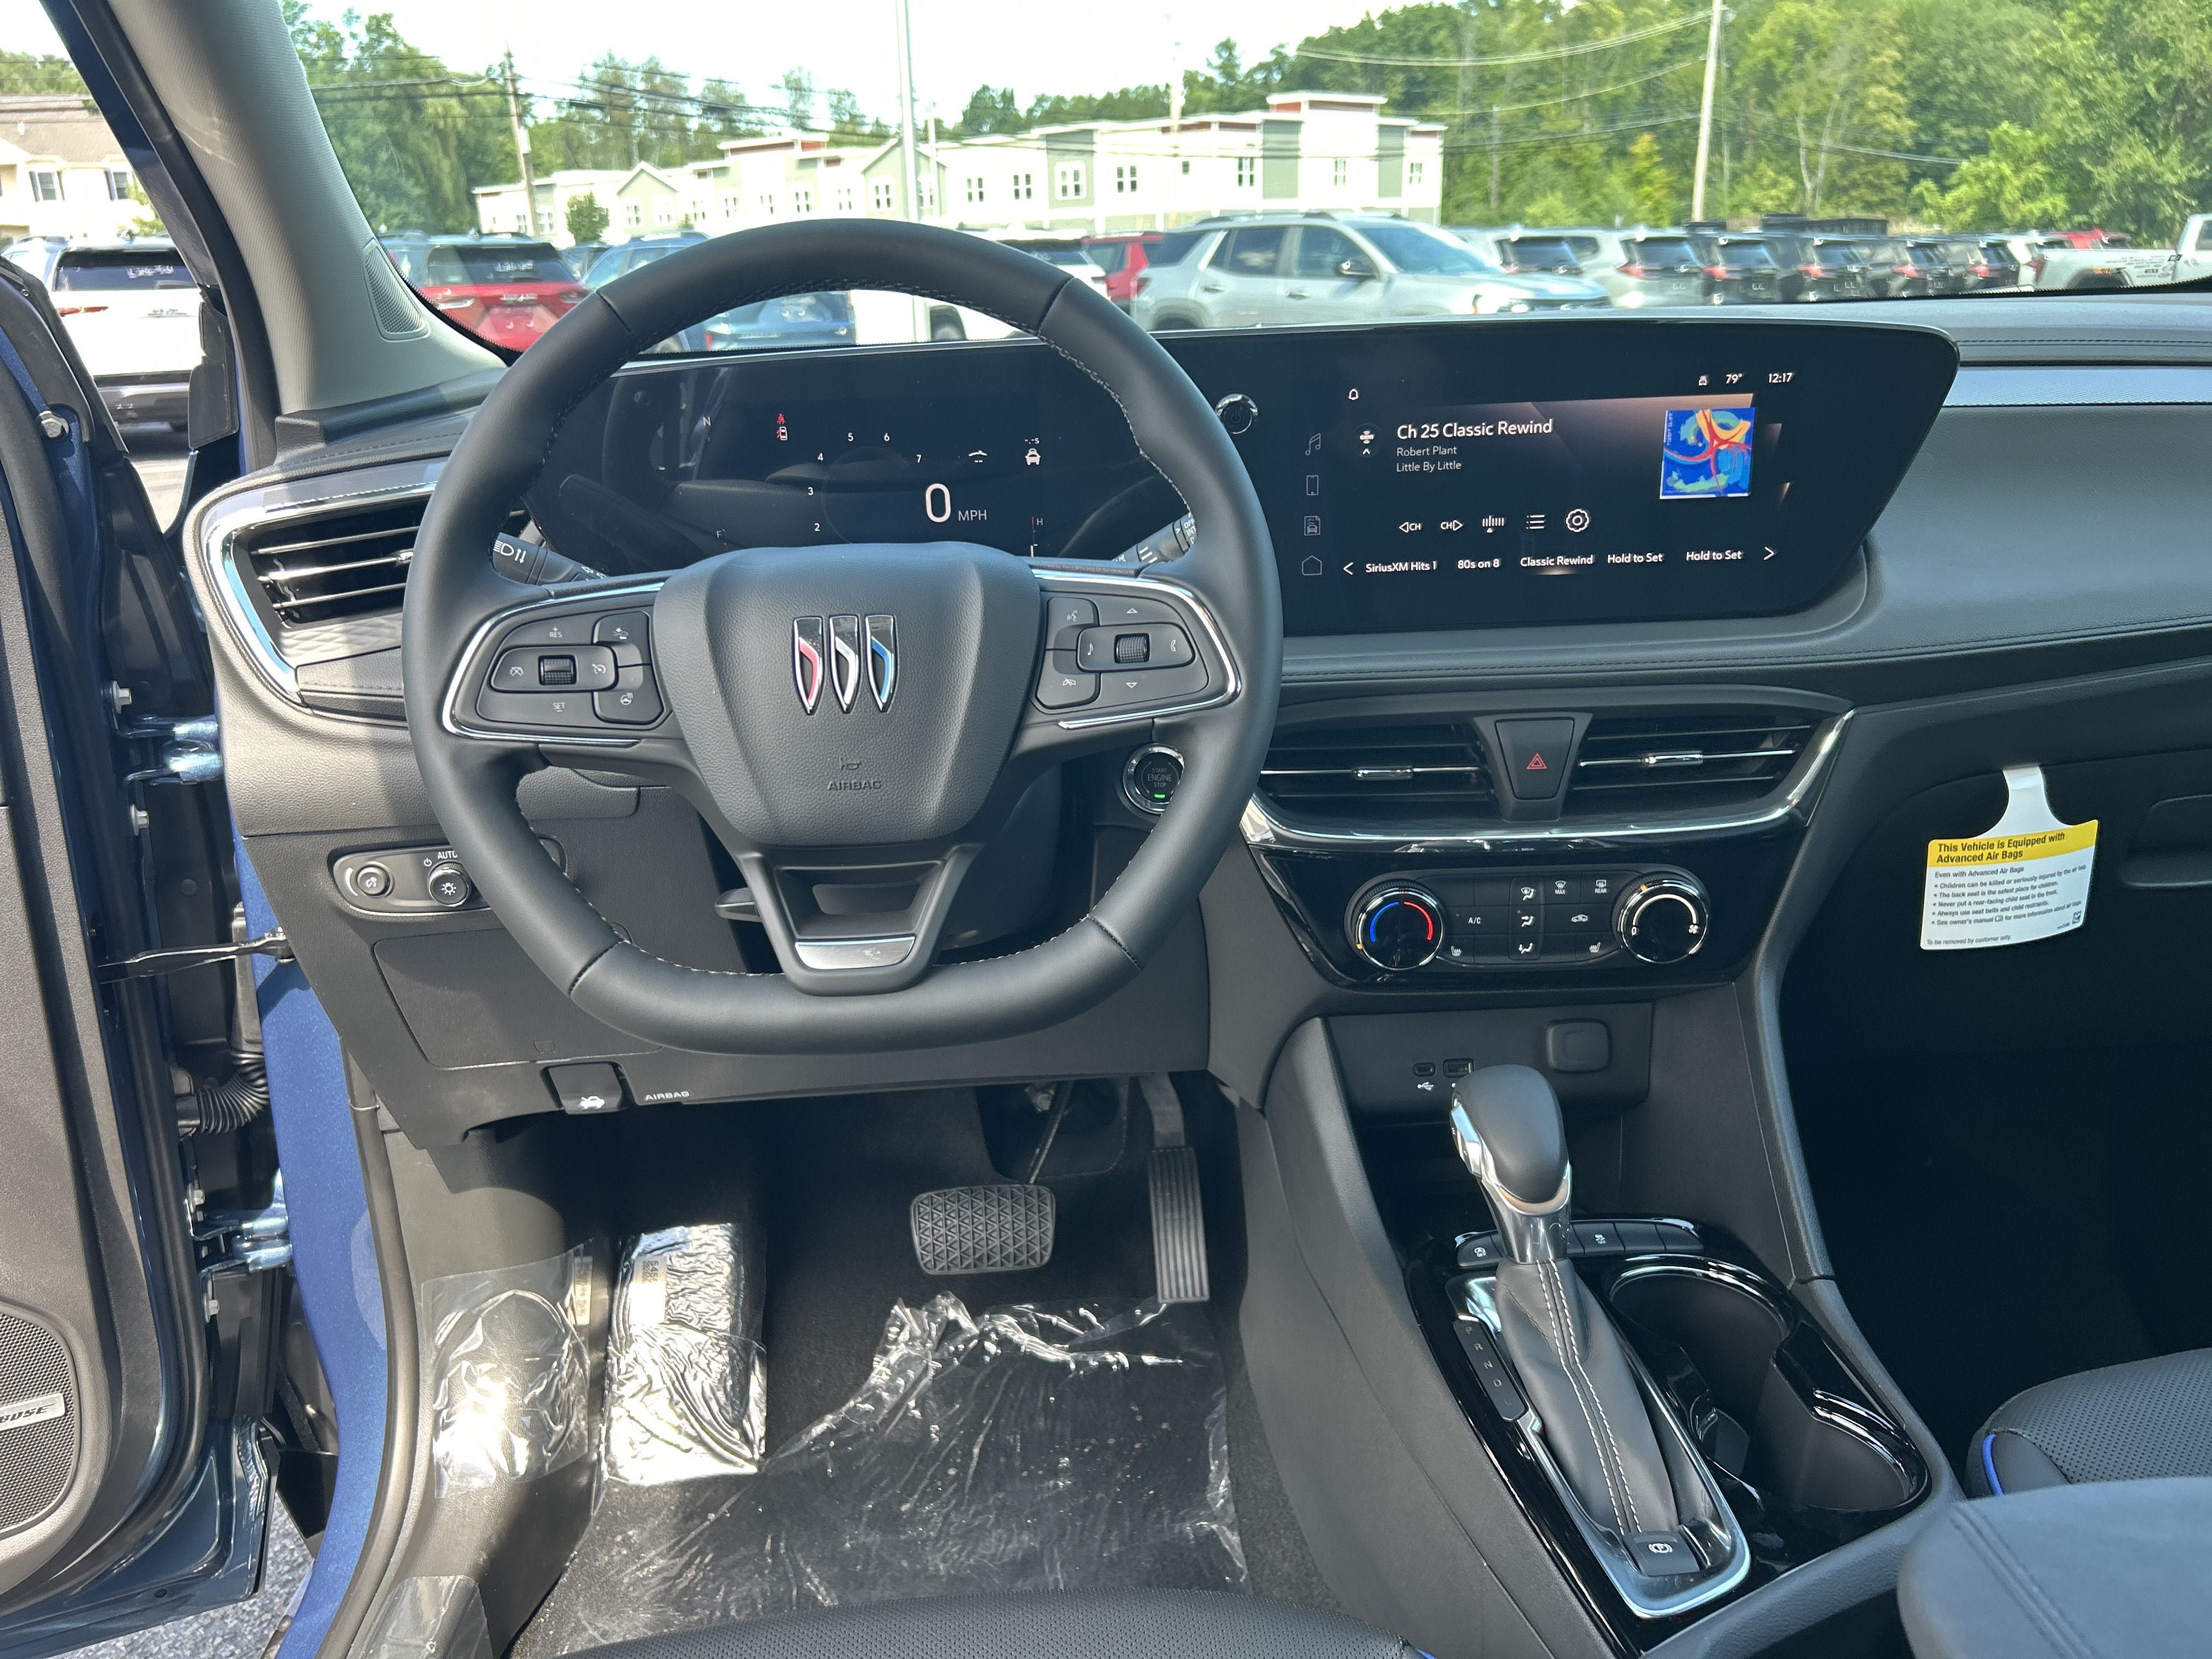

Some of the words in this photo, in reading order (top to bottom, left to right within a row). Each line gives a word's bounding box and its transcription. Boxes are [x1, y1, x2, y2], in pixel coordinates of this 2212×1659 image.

[1726, 373, 1742, 384] 79°
[1769, 373, 1793, 383] 12:17
[703, 416, 711, 426] N
[1397, 424, 1418, 439] Ch
[1420, 424, 1439, 438] 25
[1442, 422, 1493, 438] Classic
[1498, 419, 1553, 435] Rewind
[848, 433, 854, 442] 5
[884, 433, 890, 442] 6
[1396, 447, 1430, 456] Robert
[1432, 445, 1457, 455] Plant
[817, 453, 823, 461] 4
[916, 454, 922, 463] 7
[1396, 462, 1420, 472] Little
[1423, 462, 1435, 472] By
[1437, 461, 1462, 470] Little
[808, 487, 814, 496] 3
[926, 483, 951, 522] 0
[958, 509, 988, 522] MPH
[814, 523, 821, 532] 2
[1440, 522, 1453, 531] CH
[716, 531, 722, 539] F
[1607, 553, 1631, 564] Hold
[1633, 554, 1644, 563] to
[1645, 552, 1663, 562] Set
[1686, 551, 1709, 561] Hold
[1712, 552, 1723, 561] to
[1724, 550, 1742, 560] Set
[1457, 560, 1476, 569] 80s
[1492, 558, 1499, 568] 8
[1520, 557, 1554, 567] Classic
[1556, 555, 1593, 566] Rewind
[1365, 562, 1408, 573] SiriusXM
[1410, 561, 1430, 571] Hits
[1432, 561, 1436, 570] 1
[553, 702, 566, 710] SET
[1147, 774, 1172, 782] ENGINE
[828, 780, 882, 791] AIRBAG
[1938, 843, 1958, 852] This
[1961, 841, 1994, 851] Vehicle
[1997, 840, 2005, 849] is
[2007, 835, 2047, 849] Equipped
[2049, 832, 2065, 842] with
[438, 850, 458, 859] AUTO
[1937, 853, 1984, 863] Advanced
[1986, 852, 1999, 861] Air
[2002, 850, 2023, 860] Bags
[2039, 871, 2056, 880] injured
[646, 1091, 690, 1101] AIRBAG
[1465, 1326, 1472, 1334] P
[1474, 1343, 1483, 1351] R
[1483, 1360, 1493, 1369] N
[1493, 1379, 1502, 1387] D
[0, 1403, 54, 1423] BOSE
